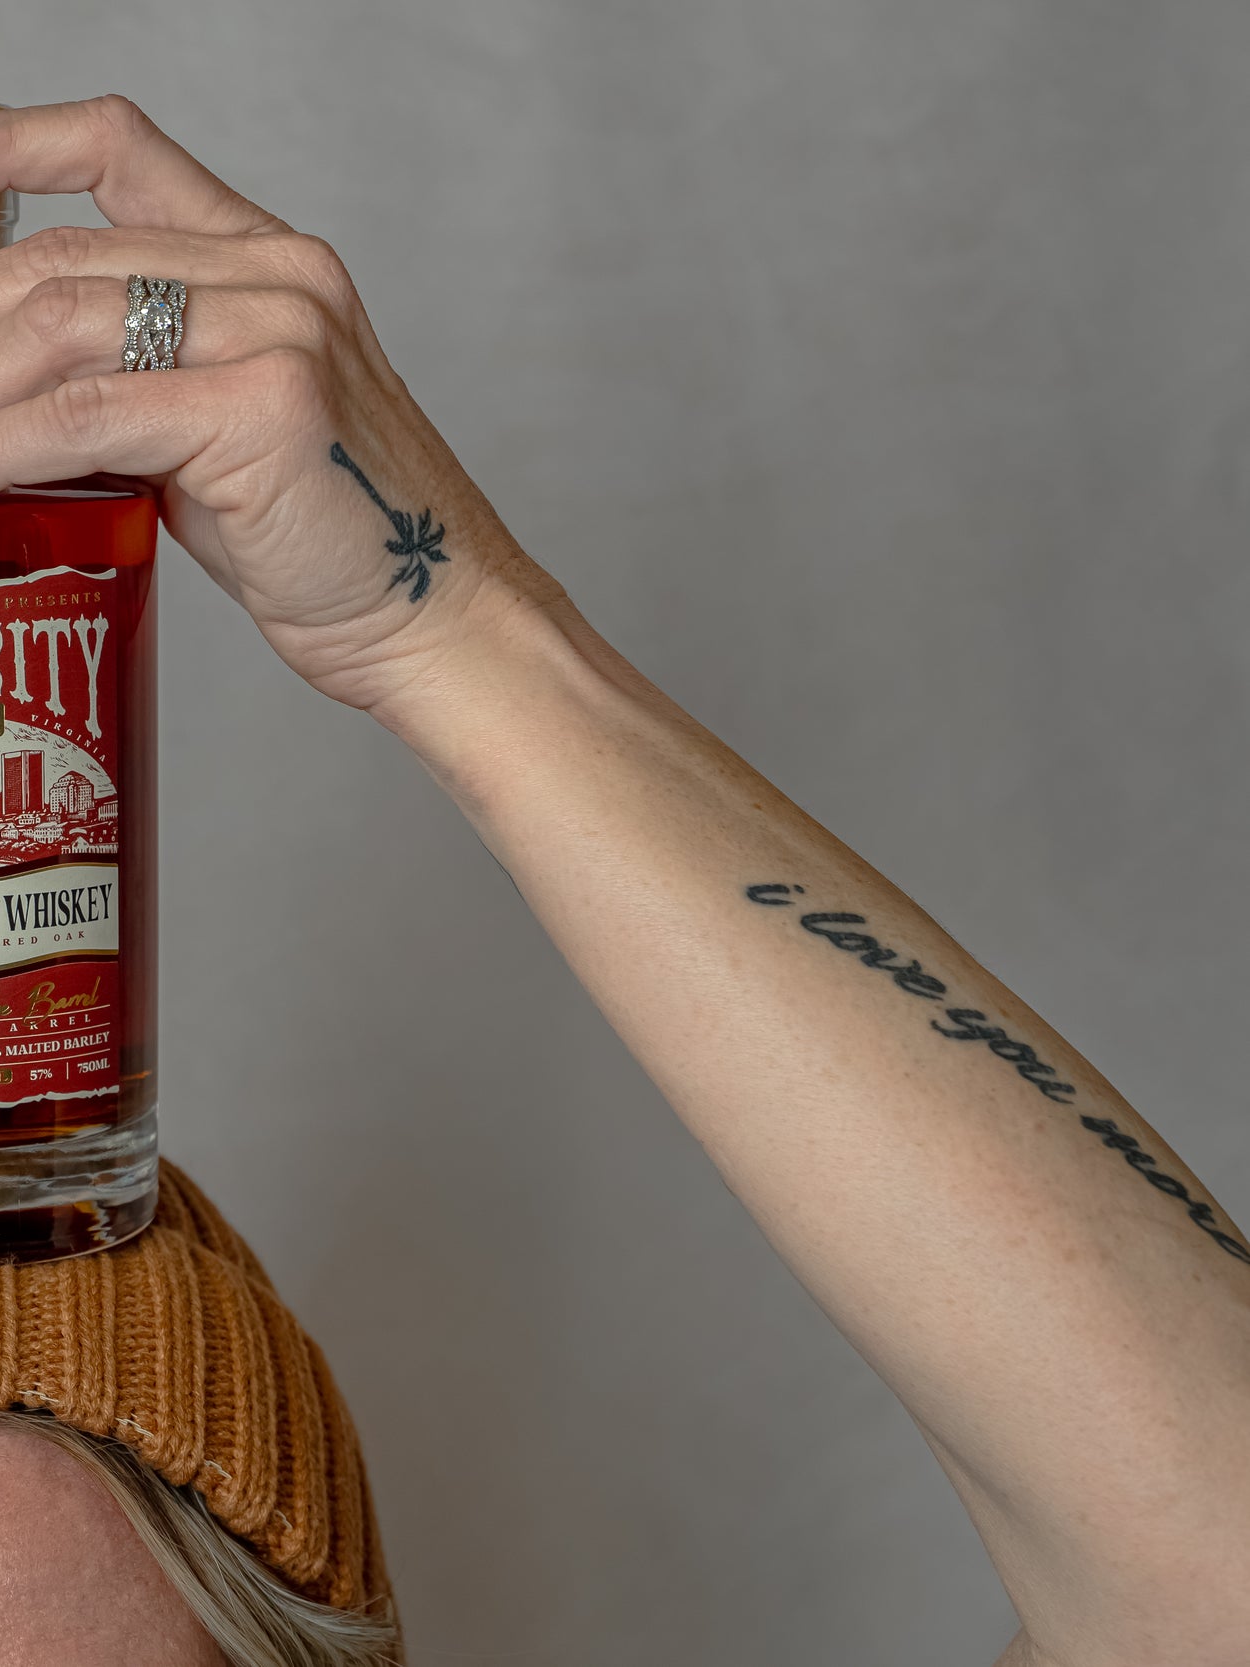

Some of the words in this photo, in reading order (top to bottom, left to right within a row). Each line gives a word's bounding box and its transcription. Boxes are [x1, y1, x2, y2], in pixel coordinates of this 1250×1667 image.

[5, 591, 101, 609] PRESENTS
[31, 714, 106, 762] VIRGINIA
[3, 884, 112, 930] WHISKEY
[54, 930, 85, 942] OAK
[24, 976, 101, 1026] Barrel
[800, 912, 947, 1000] love
[931, 1009, 1077, 1104] you
[5, 1040, 60, 1056] MALTED
[63, 1031, 110, 1050] BARLEY
[30, 1069, 53, 1081] 57%
[77, 1058, 110, 1073] 750ML
